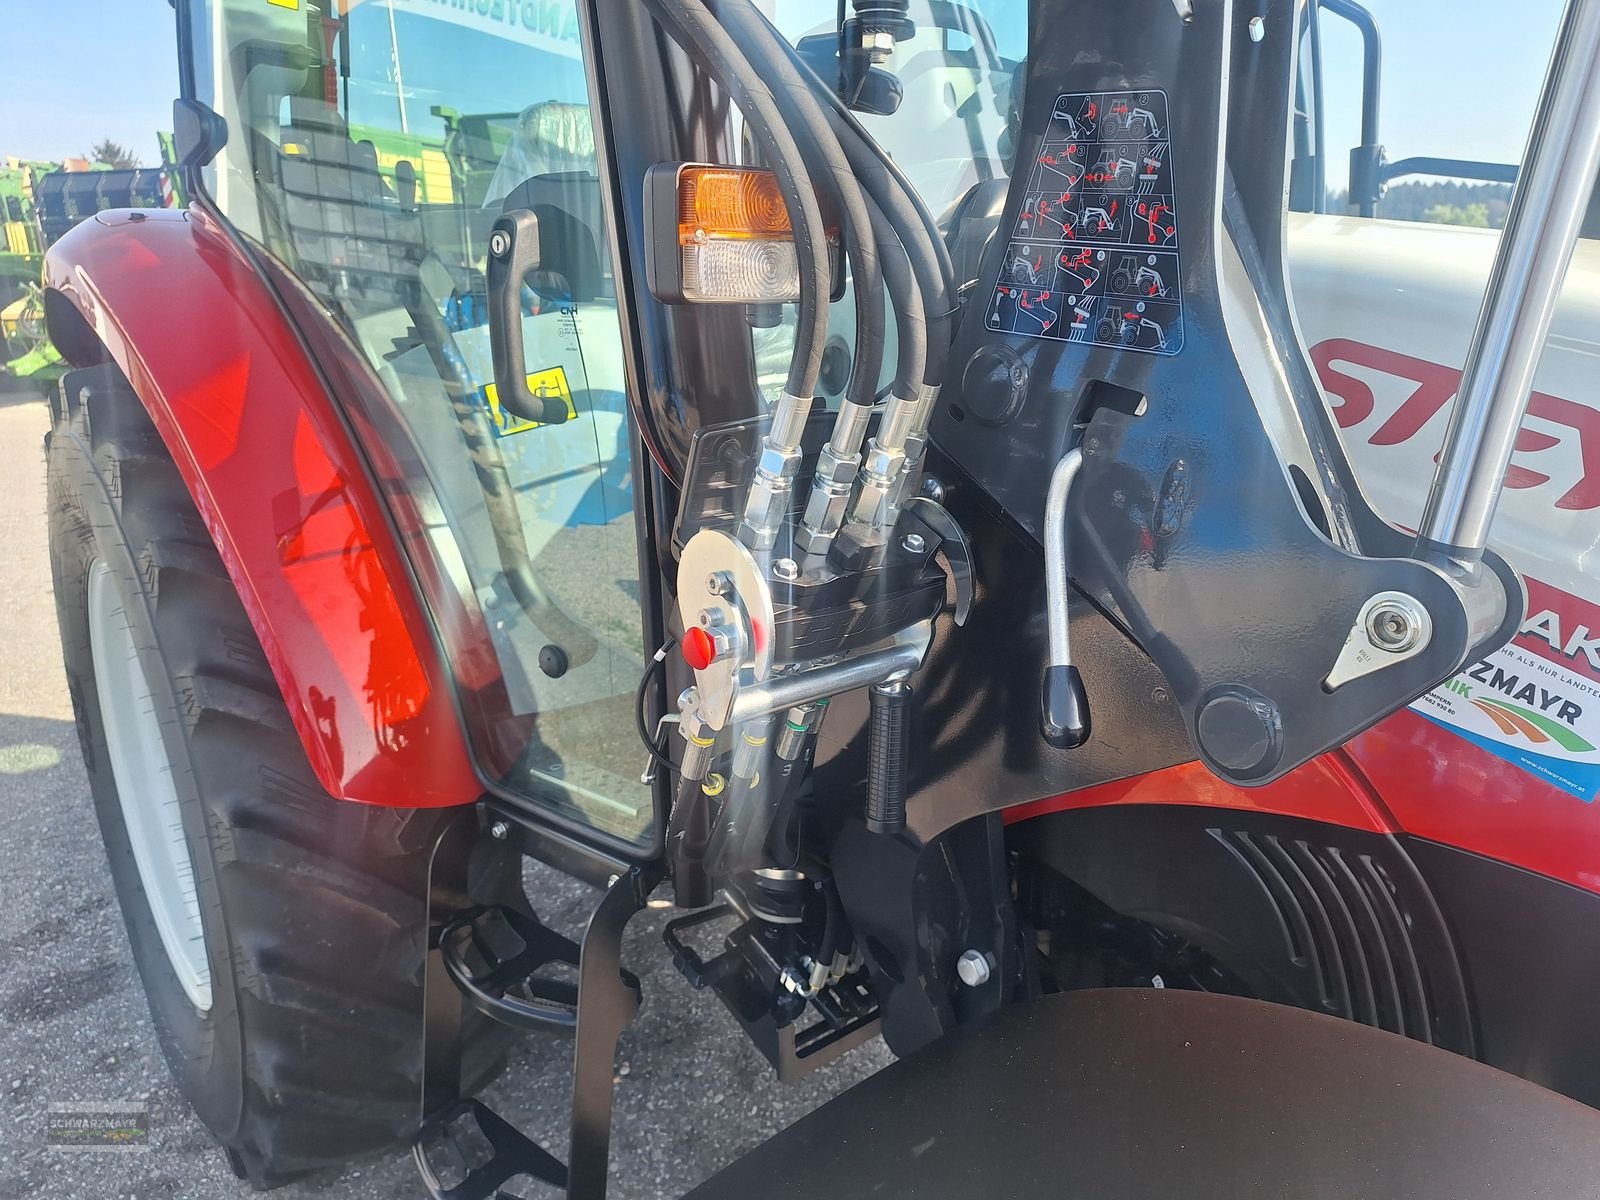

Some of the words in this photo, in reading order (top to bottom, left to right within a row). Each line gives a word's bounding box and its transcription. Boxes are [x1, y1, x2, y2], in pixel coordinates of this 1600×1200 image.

[1462, 660, 1583, 726] ZMAYR
[1517, 655, 1535, 667] ALS
[1537, 665, 1558, 677] NUR
[1560, 675, 1600, 699] LANDTE
[1520, 757, 1586, 792] www.schwarzmayr.at
